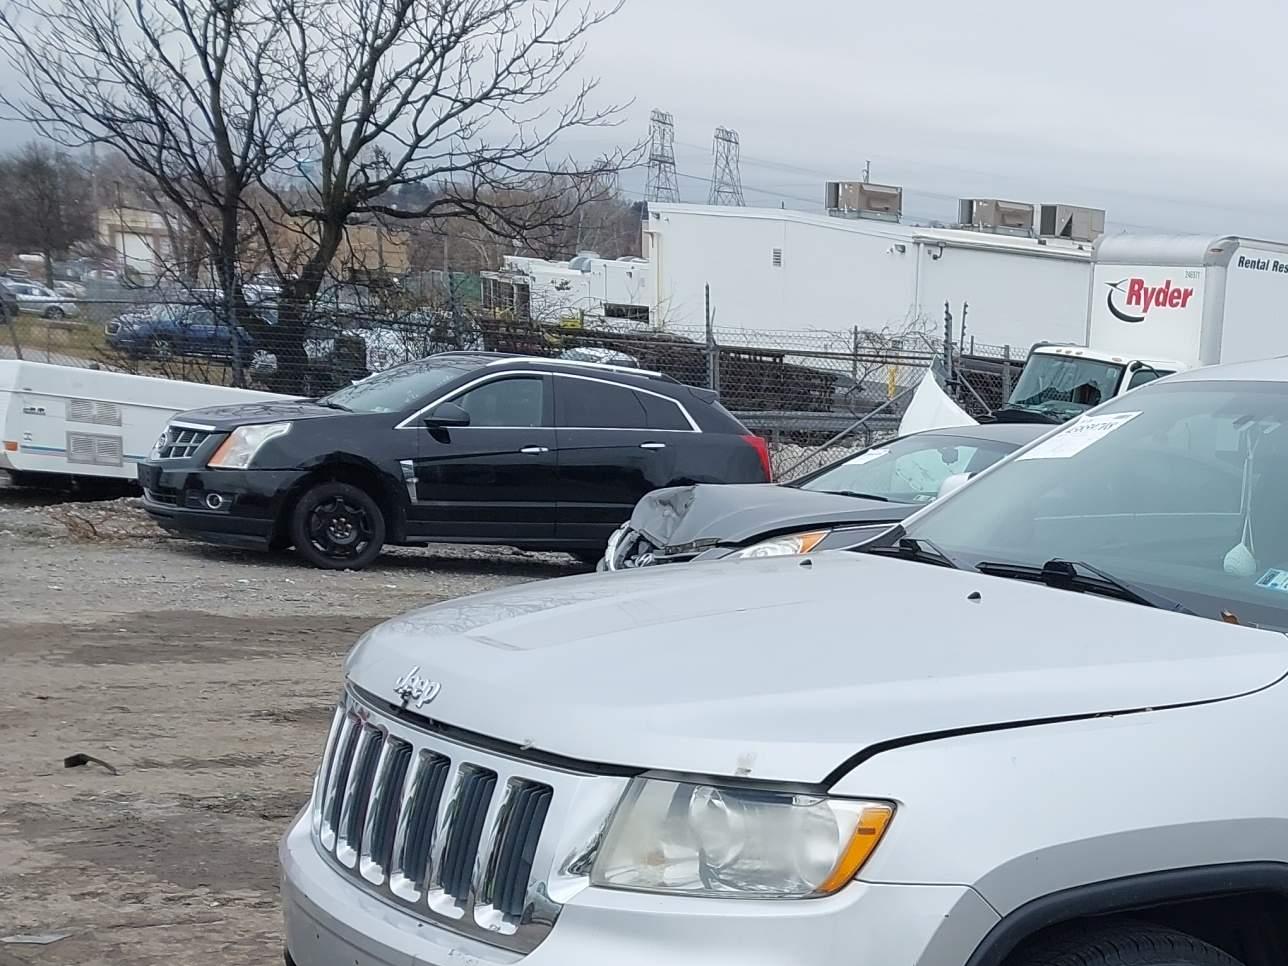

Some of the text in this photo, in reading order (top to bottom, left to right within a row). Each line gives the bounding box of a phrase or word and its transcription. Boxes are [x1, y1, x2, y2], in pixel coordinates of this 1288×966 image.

[1238, 256, 1270, 271] Rental
[1126, 278, 1194, 313] Ryder
[393, 666, 441, 709] Jeep
